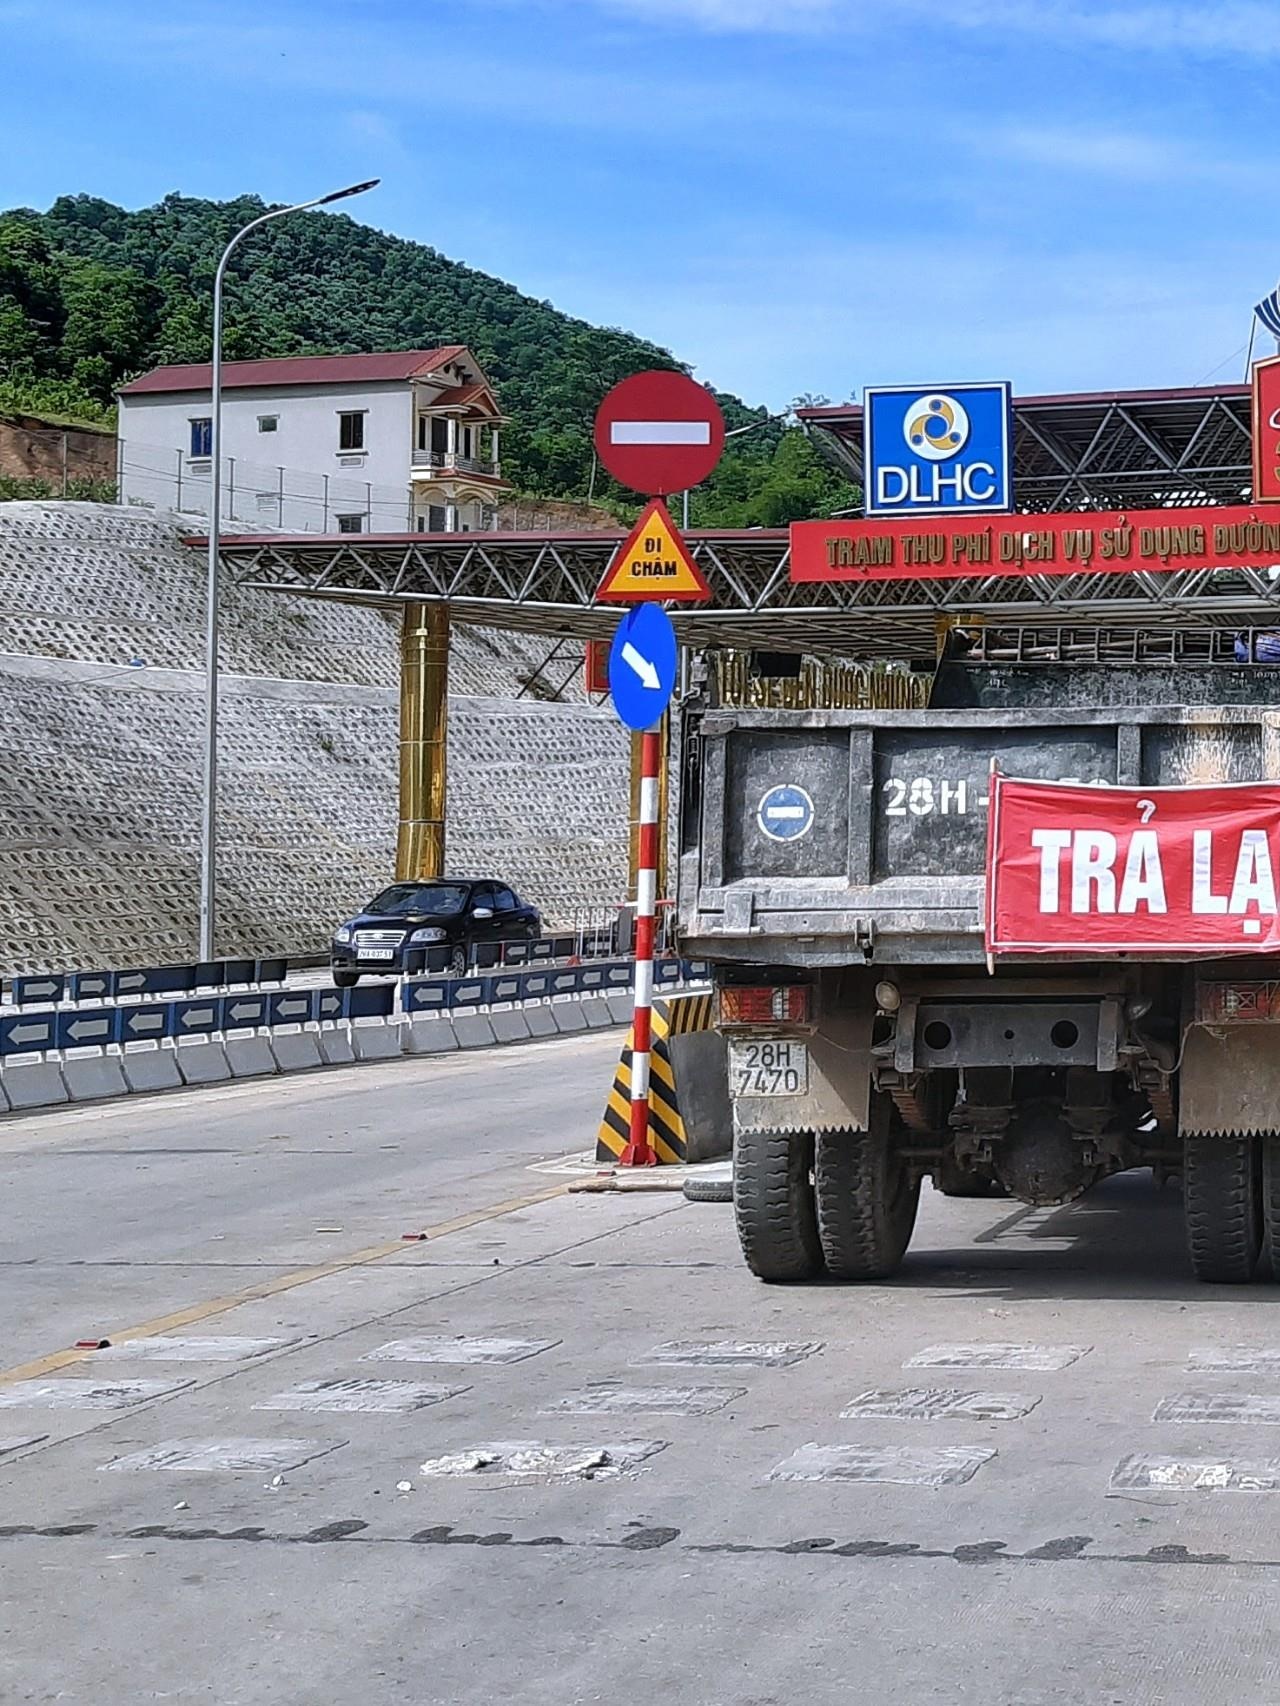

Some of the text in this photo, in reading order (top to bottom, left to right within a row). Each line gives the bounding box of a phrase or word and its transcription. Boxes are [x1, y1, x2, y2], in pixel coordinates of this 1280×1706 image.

[877, 462, 996, 504] DLHC
[645, 538, 661, 553] ĐI
[826, 536, 892, 572] TRẠM
[900, 533, 944, 564] THU
[952, 525, 992, 563] PHÍ
[1000, 531, 1053, 566] DỊCH
[1062, 529, 1092, 565] VỤ
[1100, 515, 1134, 557] SỬ
[1140, 524, 1204, 562] DỤNG
[632, 557, 677, 580] CHẬM
[1031, 799, 1168, 914] TRẢ
[746, 1043, 790, 1068] 28H
[738, 1069, 798, 1095] 7470
